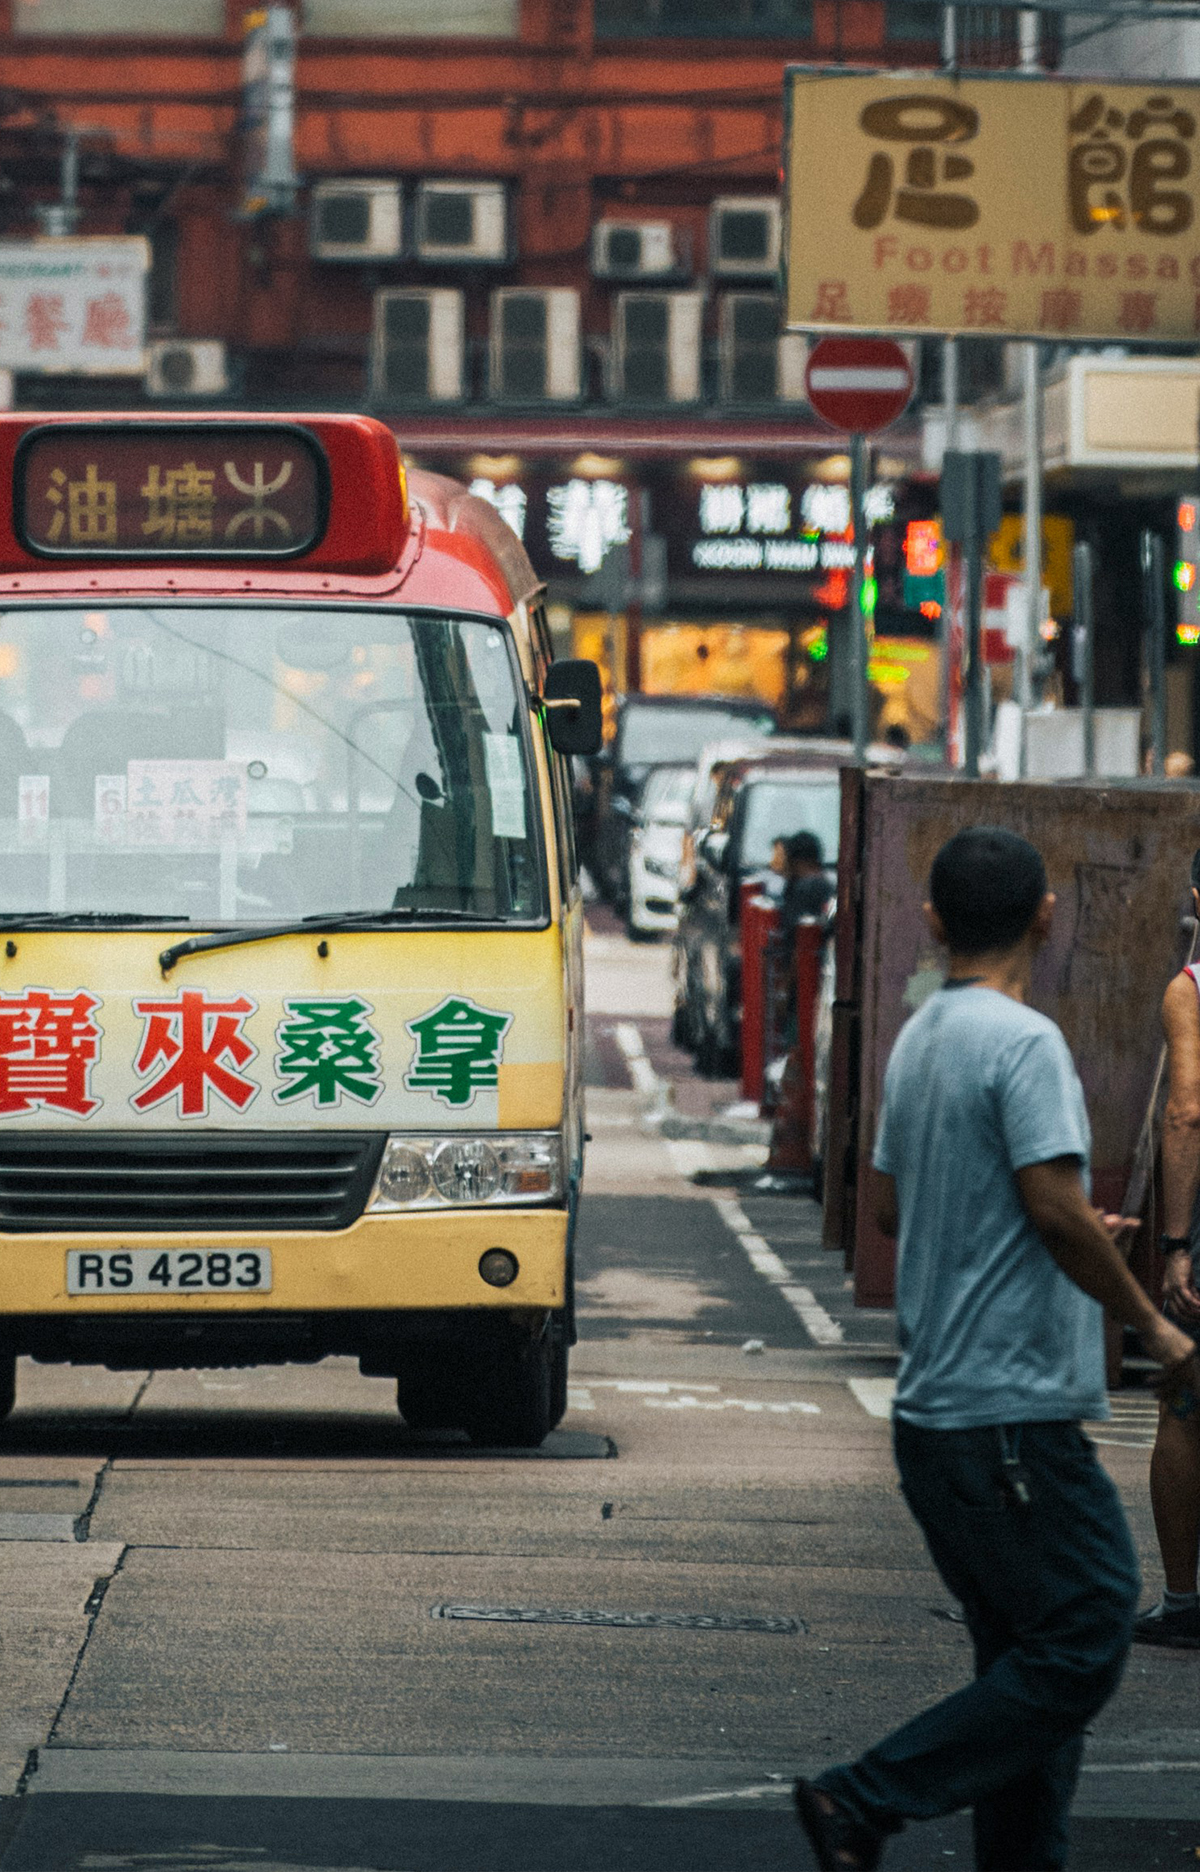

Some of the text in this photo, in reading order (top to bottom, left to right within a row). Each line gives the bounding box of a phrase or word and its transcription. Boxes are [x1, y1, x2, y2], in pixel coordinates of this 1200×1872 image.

[872, 235, 994, 275] Foot
[45, 462, 218, 544] 油塘
[79, 1251, 262, 1289] RS 4283
